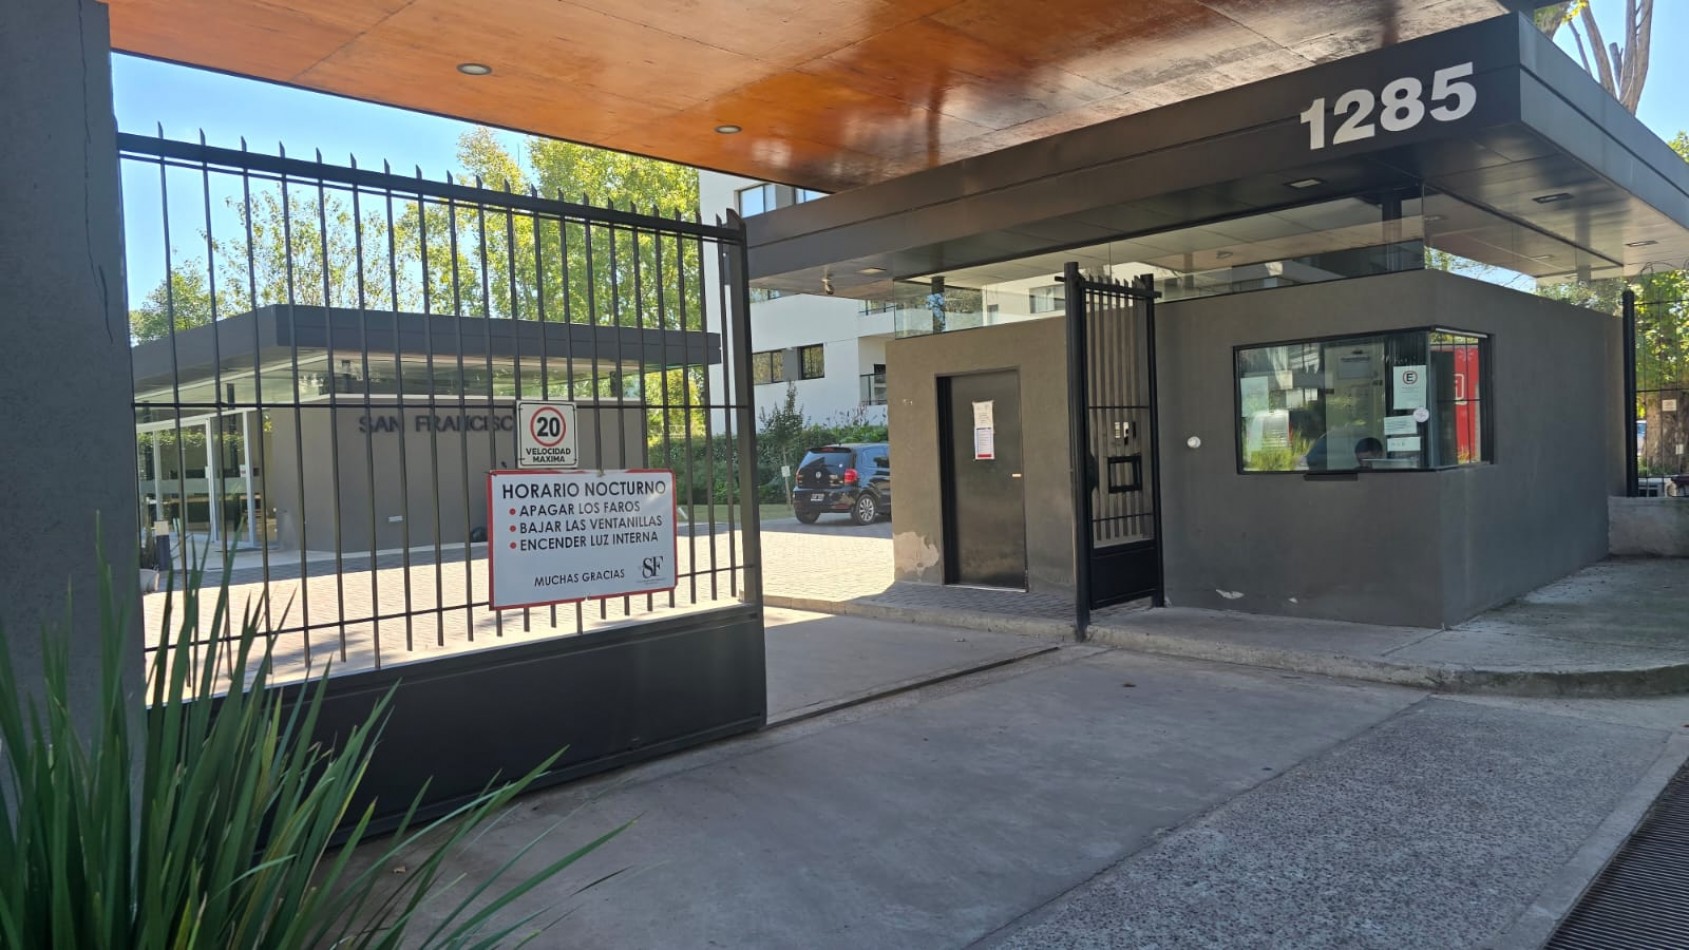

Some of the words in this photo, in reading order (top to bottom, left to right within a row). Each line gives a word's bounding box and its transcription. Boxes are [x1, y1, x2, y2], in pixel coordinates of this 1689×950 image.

[1300, 61, 1477, 150] 1285
[415, 415, 513, 432] FRANCISC
[536, 416, 560, 437] 20
[526, 447, 571, 455] VELOCIDAD
[532, 455, 566, 463] MAXIMA
[502, 482, 580, 499] HORARIO
[585, 480, 666, 496] NOCTURNO
[519, 503, 575, 516] APAGAR
[578, 502, 600, 514] LOS
[603, 501, 640, 513] FAROS
[520, 521, 562, 534] BAJAR
[565, 519, 587, 531] LAS
[589, 515, 663, 530] VENTANILLAS
[520, 535, 587, 551] ENCENDER
[590, 534, 609, 546] LUZ
[612, 531, 658, 545] INTERNA
[534, 573, 579, 587] MUCHAS
[581, 568, 625, 582] GRACIAS
